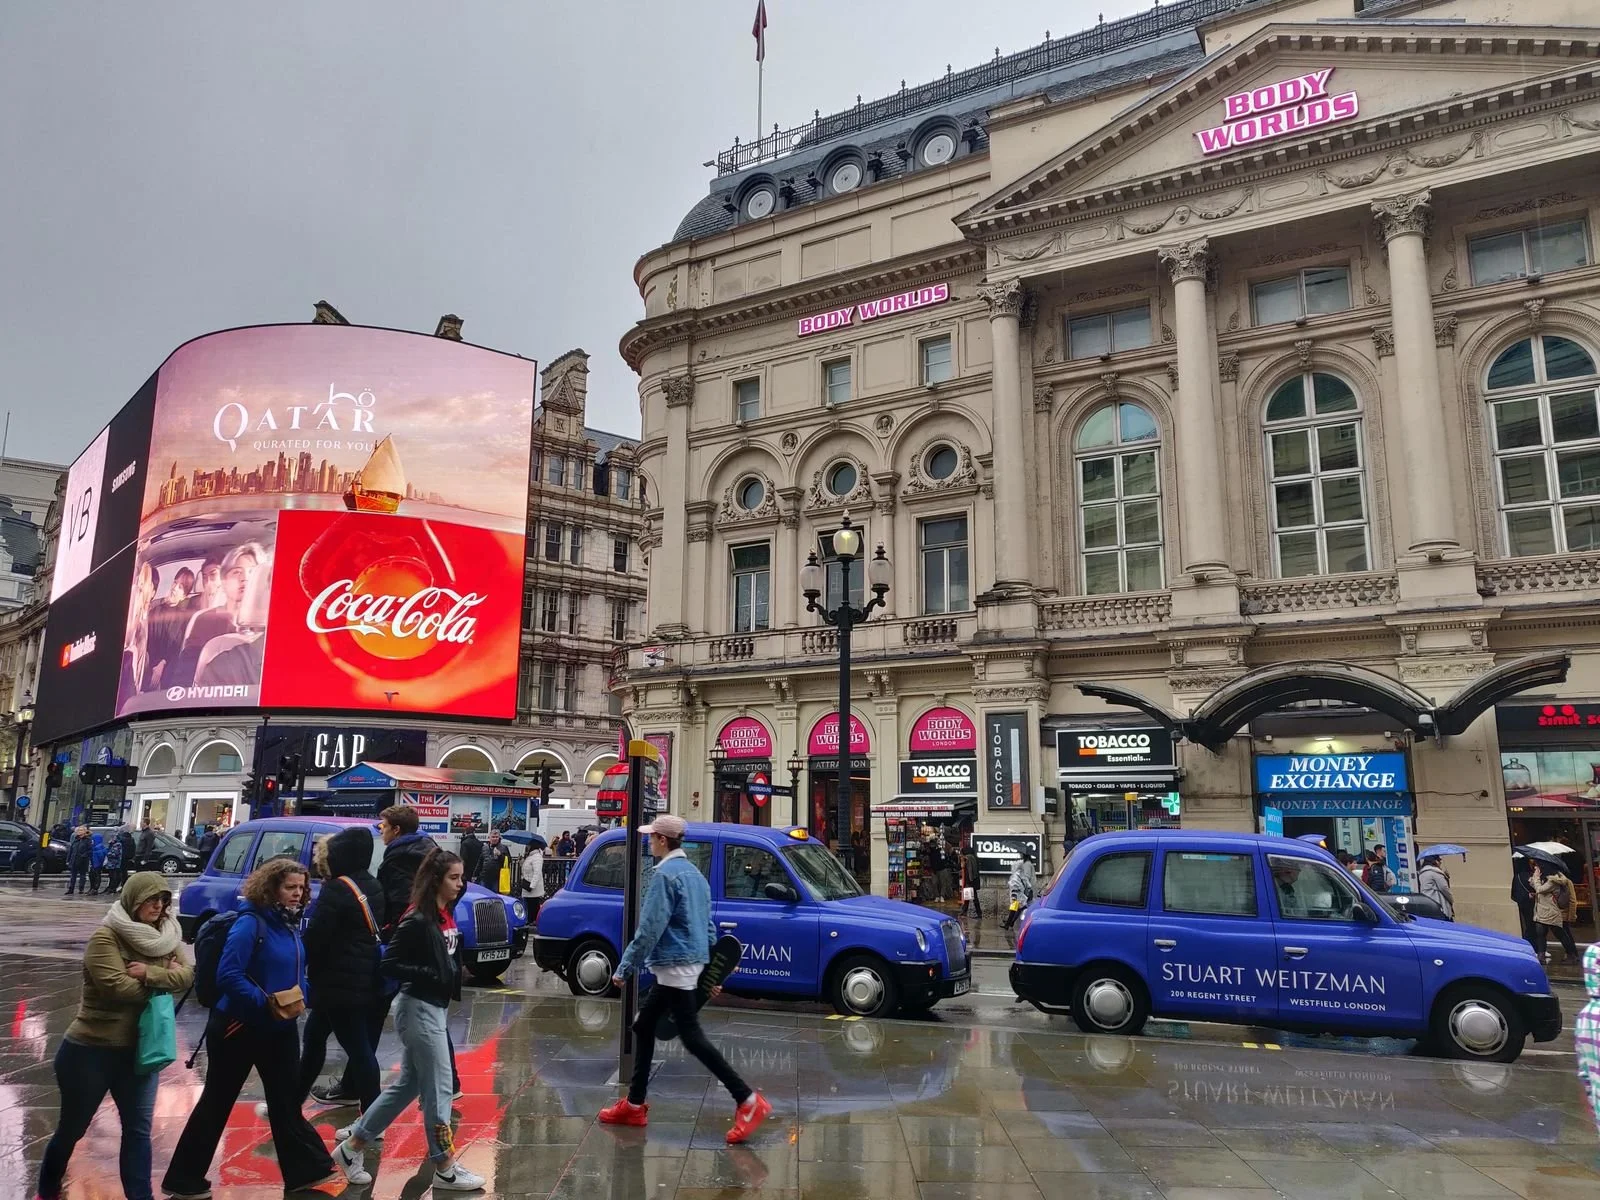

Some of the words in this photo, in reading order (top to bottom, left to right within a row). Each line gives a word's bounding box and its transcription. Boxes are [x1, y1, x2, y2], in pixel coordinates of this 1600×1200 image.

[1223, 67, 1335, 121] BODY
[1195, 91, 1358, 154] WORLDS
[798, 307, 855, 337] BODY
[858, 282, 949, 321] WORLDS
[213, 402, 375, 452] QATAR
[254, 439, 311, 451] QURATED
[316, 440, 341, 449] FOR
[69, 486, 92, 551] VB
[188, 685, 248, 698] HYUNDAI
[1538, 704, 1581, 726] simit
[824, 723, 856, 734] BOY
[928, 719, 962, 730] BODY
[730, 728, 760, 739] BODY
[918, 729, 972, 740] WORLDS
[723, 737, 767, 748] WORLDS
[1078, 734, 1150, 749] TOBACCO
[315, 733, 365, 768] GAP
[721, 764, 769, 772] ATTRACTION
[816, 760, 866, 769] ATTRAION
[993, 723, 1004, 806] TOBACCO
[1289, 756, 1374, 772] MONEY
[912, 765, 970, 777] TOBACCO
[1270, 773, 1395, 789] EXCHANGE
[421, 795, 432, 803] THE
[1271, 800, 1318, 810] MONEY
[1323, 799, 1403, 810] EXCHANGE
[433, 808, 448, 816] TOUR
[740, 943, 792, 963] ZMAN
[759, 968, 791, 977] LONDON
[1162, 962, 1246, 986] STUART
[1255, 968, 1386, 994] WEITZMAN
[1170, 990, 1185, 998] 200
[1187, 991, 1221, 1000] REGENT
[1224, 993, 1257, 1002] STREET
[1290, 998, 1341, 1009] WESTFIELD
[1343, 1001, 1386, 1011] LONDON
